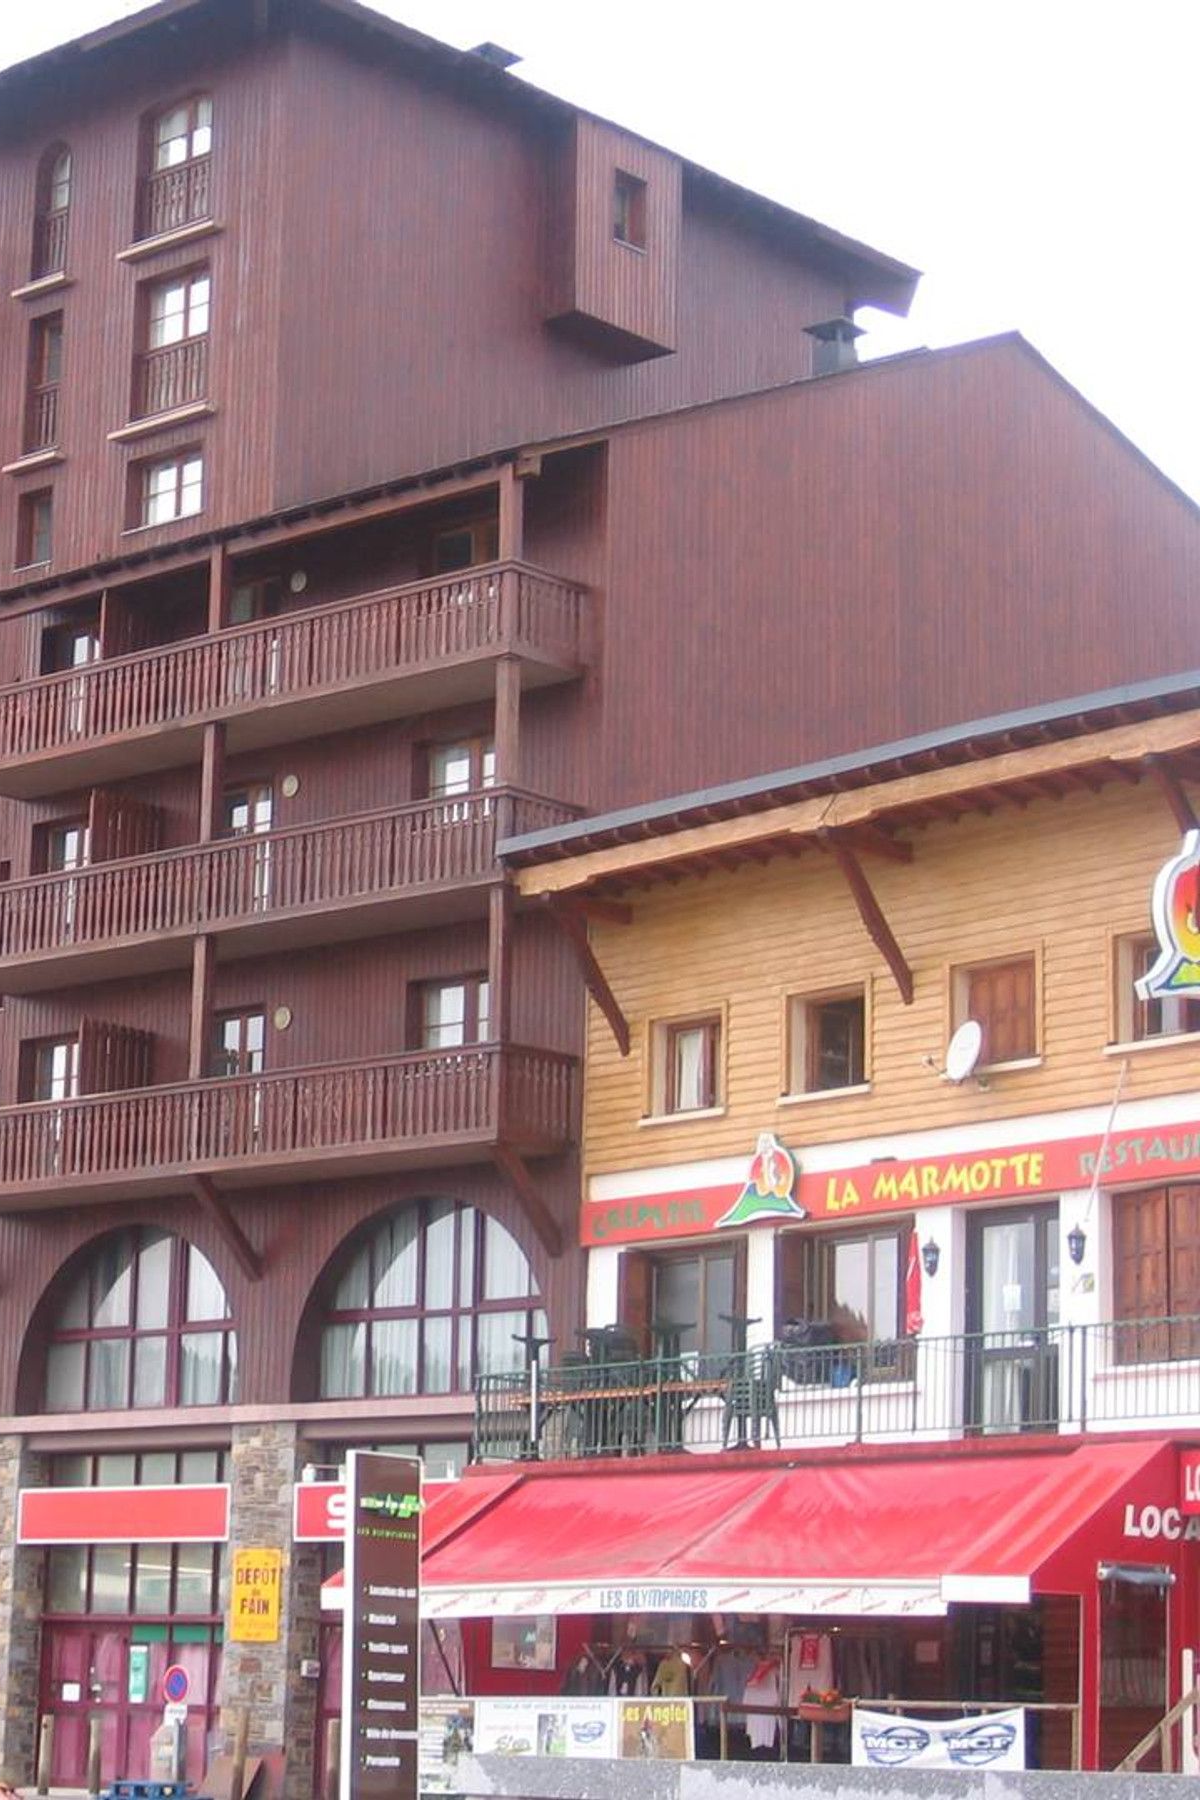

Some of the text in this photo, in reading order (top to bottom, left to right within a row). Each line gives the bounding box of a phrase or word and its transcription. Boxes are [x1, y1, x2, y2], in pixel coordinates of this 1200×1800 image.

[826, 1153, 1044, 1211] LA MARMOTTE
[240, 1598, 270, 1614] PAIN
[600, 1590, 622, 1608] LES
[626, 1588, 708, 1608] OLYMPIADES
